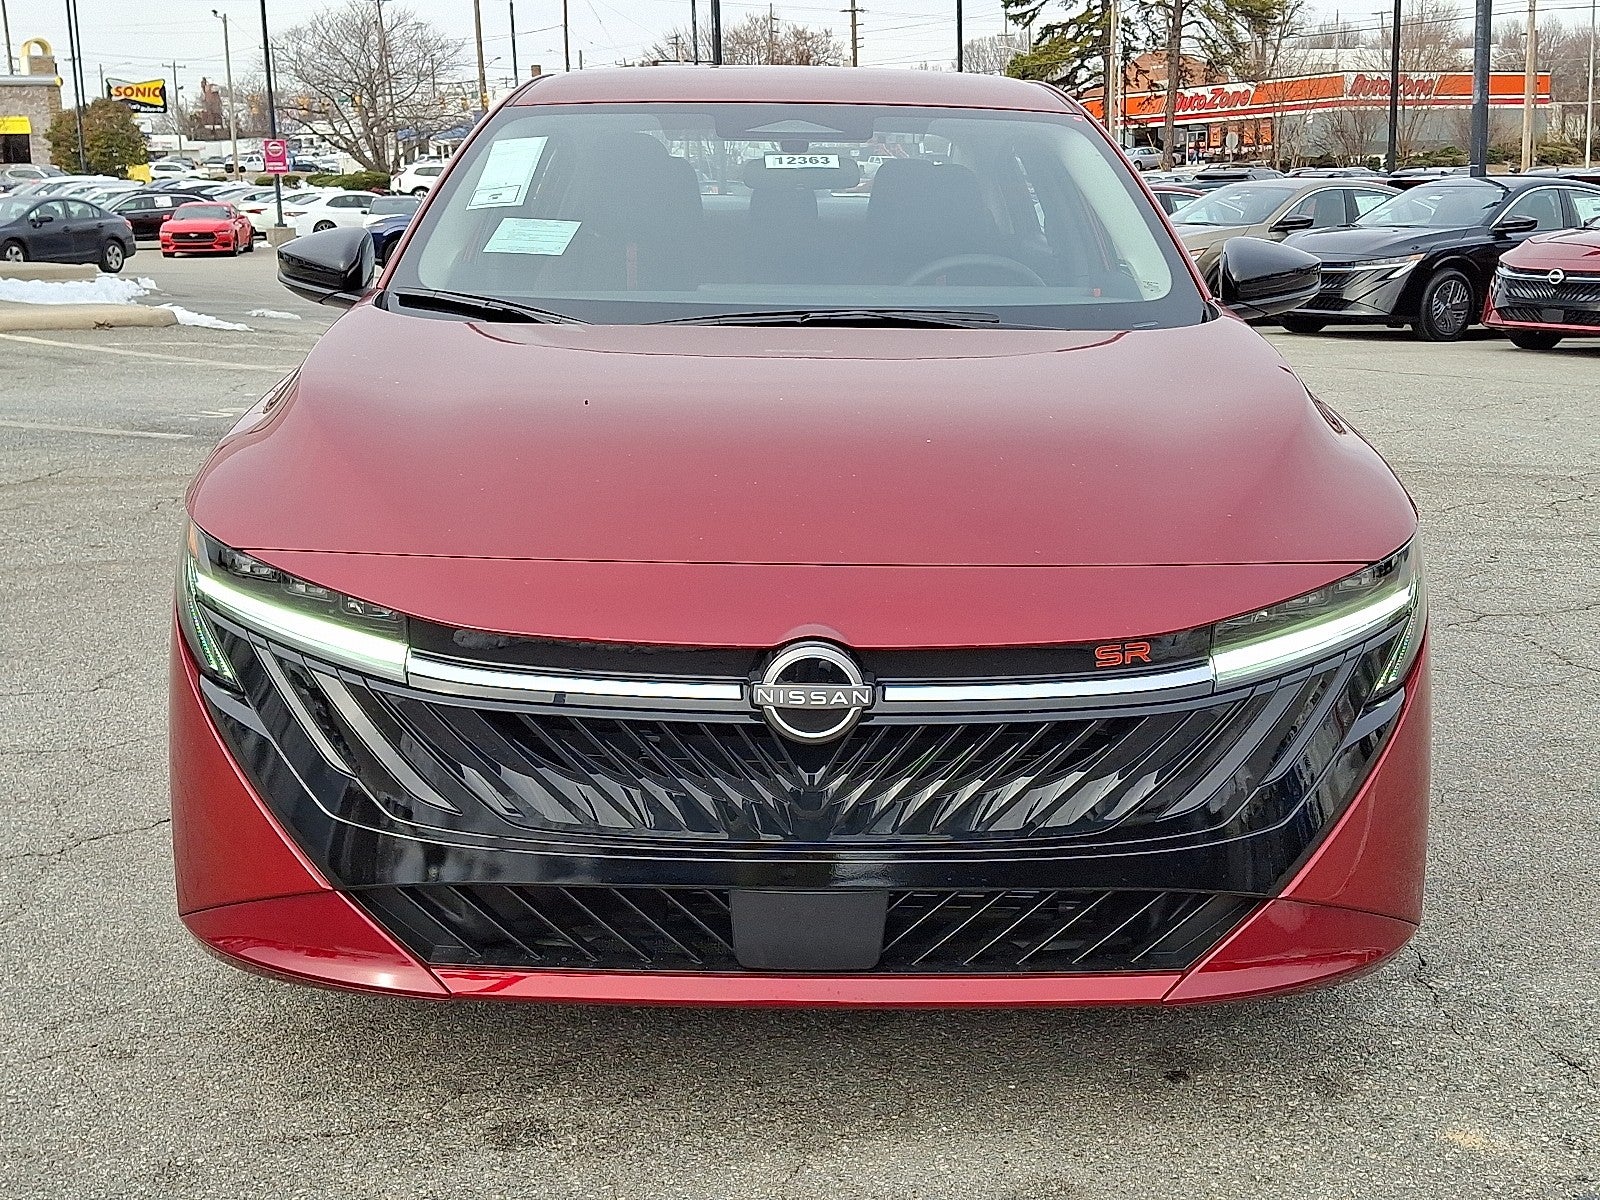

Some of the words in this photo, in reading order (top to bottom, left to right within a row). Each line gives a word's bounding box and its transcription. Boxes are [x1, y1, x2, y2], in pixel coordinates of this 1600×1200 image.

[114, 86, 160, 98] SONIC
[774, 156, 831, 165] 12363
[1095, 642, 1152, 667] SR
[757, 689, 869, 705] NISSAN
